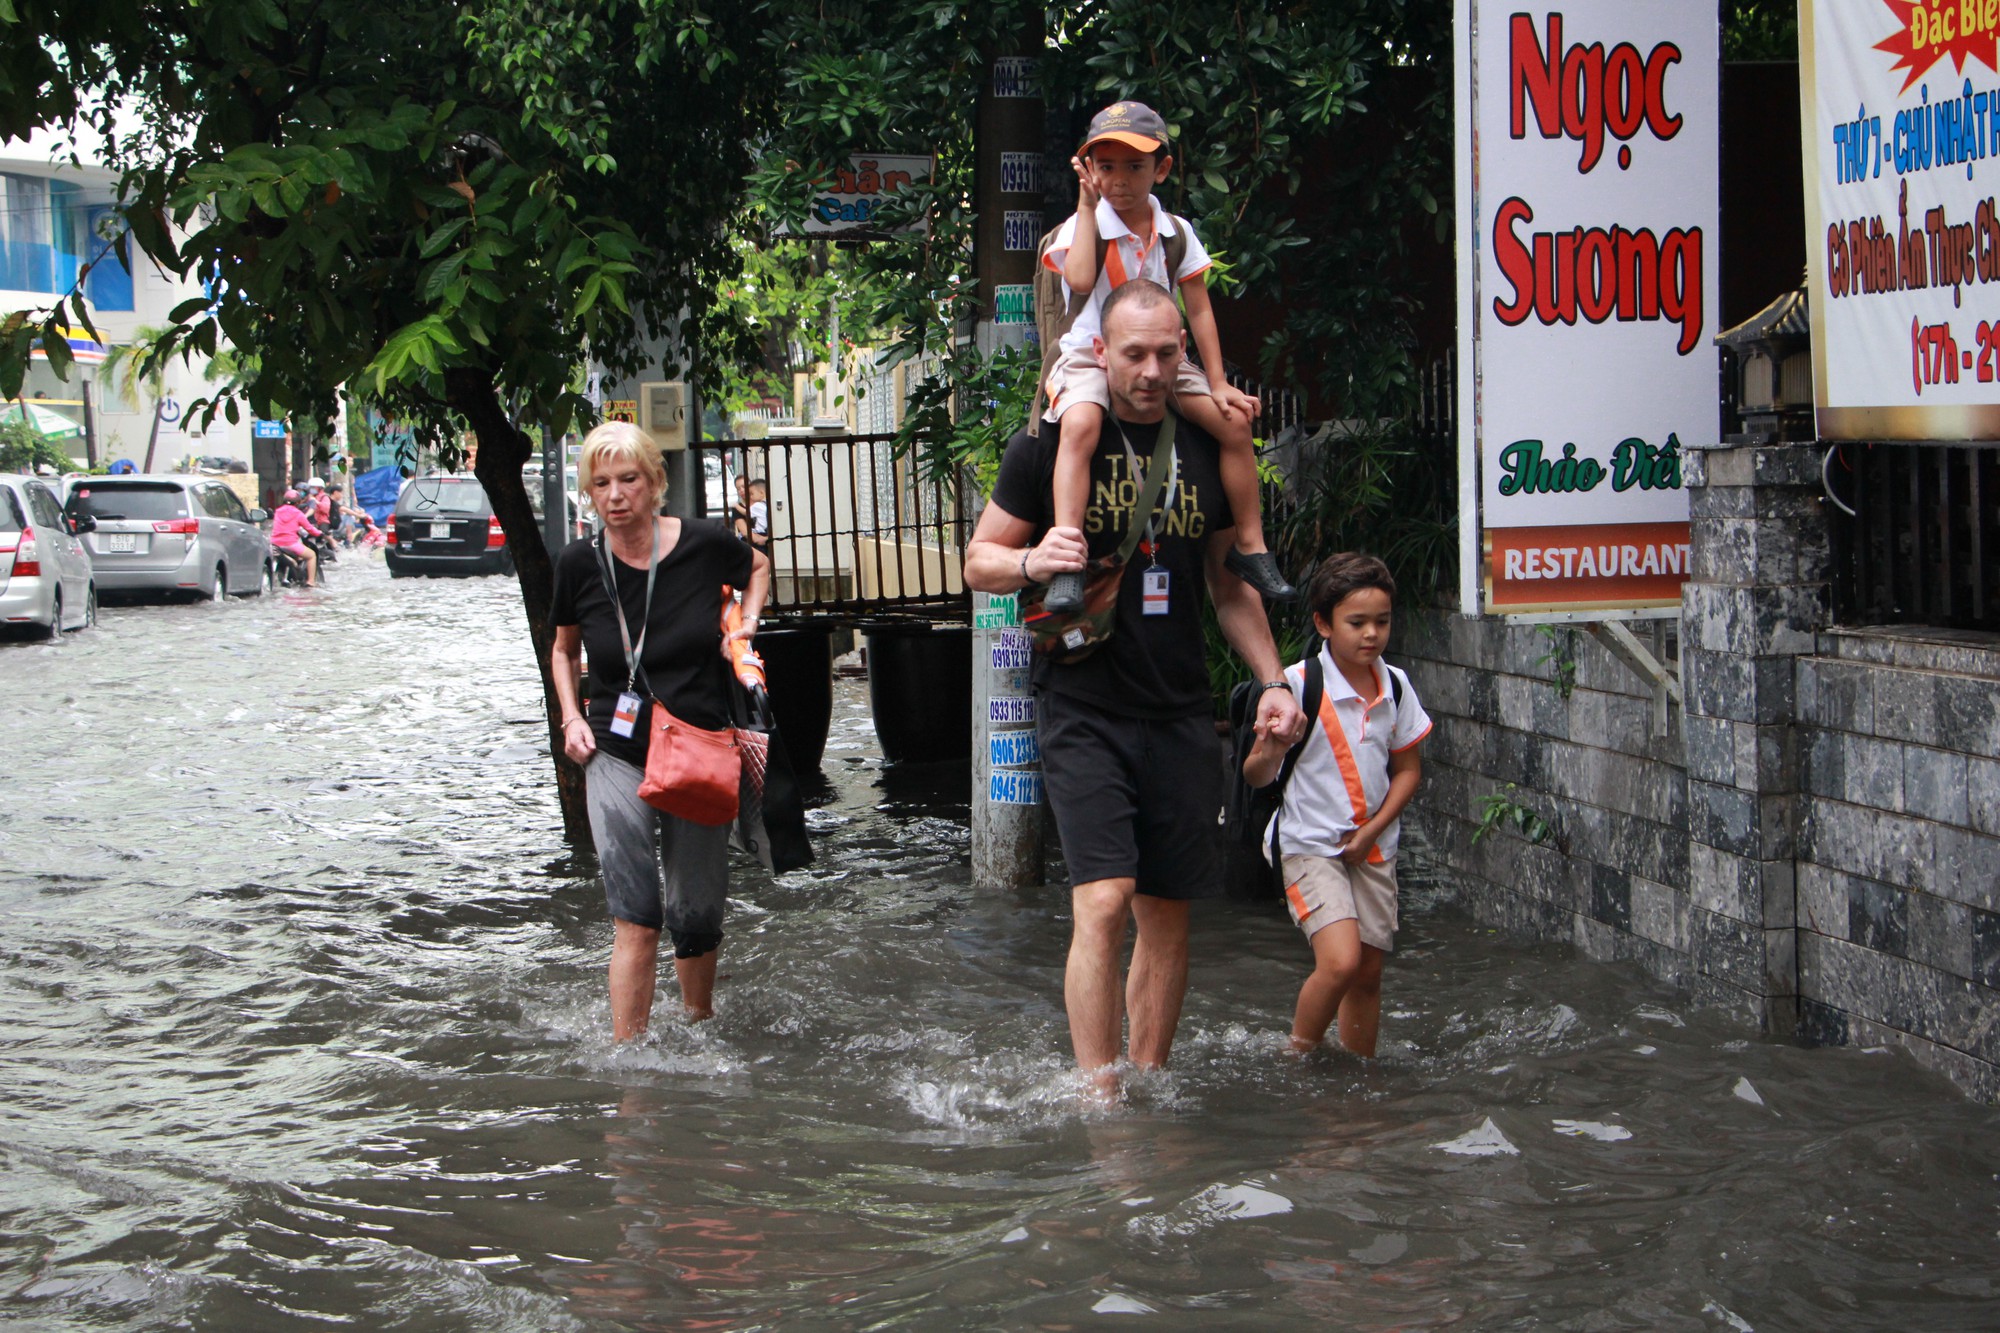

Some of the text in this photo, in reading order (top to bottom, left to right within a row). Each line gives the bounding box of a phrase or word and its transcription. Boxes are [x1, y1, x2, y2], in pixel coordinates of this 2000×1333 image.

[1509, 12, 1683, 174] Ngọc
[1833, 102, 1870, 185] THỨ
[1871, 116, 1881, 178] 7
[1893, 83, 1932, 175] CHỦ
[1934, 77, 1988, 181] NHẬT
[1492, 196, 1703, 356] Sương
[1827, 219, 1849, 298] Có
[1849, 214, 1897, 295] Phiên
[1898, 178, 1927, 291] Ẩm
[1925, 204, 1975, 309] Thực
[1912, 314, 1959, 396] (17h
[1498, 438, 1608, 496] Thảo
[1504, 543, 1691, 580] RESTAURANT
